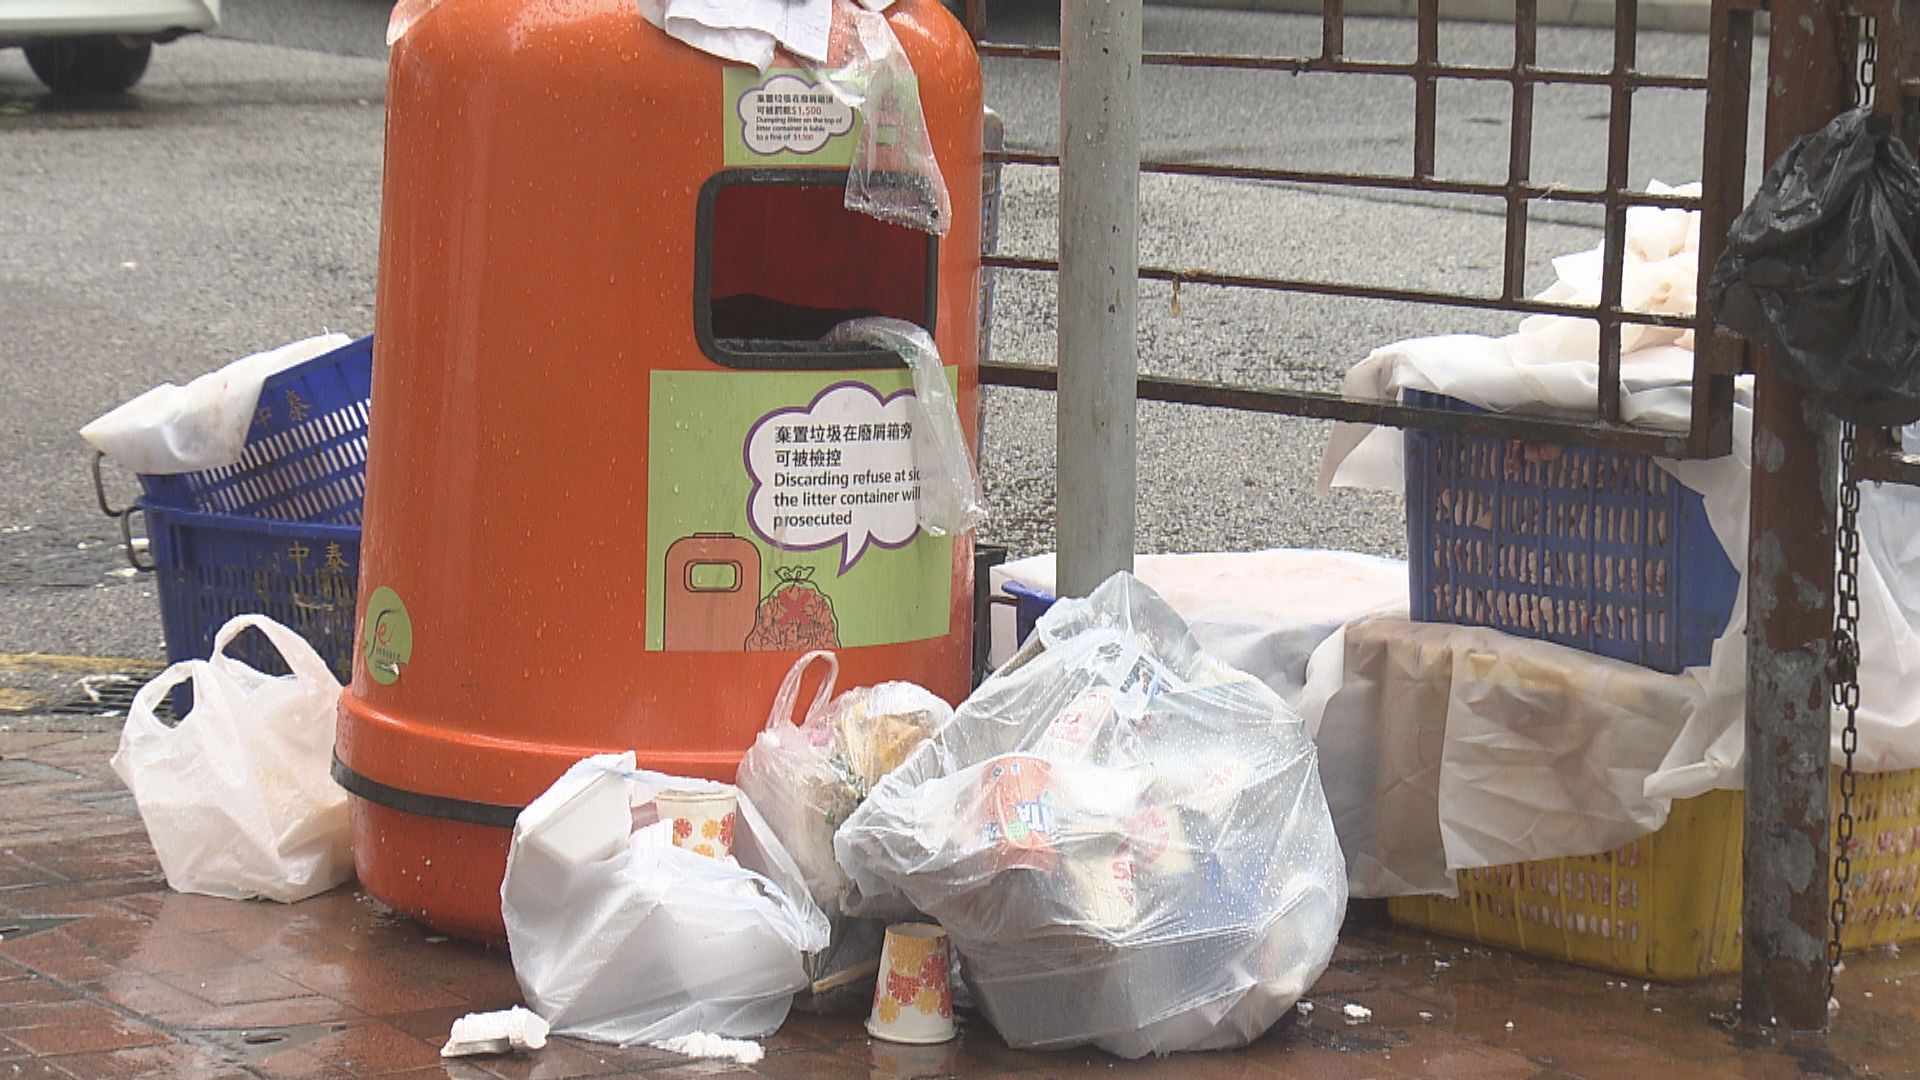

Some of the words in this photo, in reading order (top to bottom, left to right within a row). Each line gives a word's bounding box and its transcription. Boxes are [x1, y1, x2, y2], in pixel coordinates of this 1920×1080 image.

[756, 116, 786, 124] Dumping
[824, 117, 835, 125] top
[775, 422, 913, 443] 棄置垃圾在廢屑箱旁
[775, 448, 842, 467] 可被檢控
[774, 471, 849, 489] Discarding
[853, 468, 892, 485] refuse
[894, 470, 906, 482] at
[774, 492, 799, 507] the
[802, 491, 837, 506] litter
[840, 488, 900, 505] container
[902, 486, 921, 502] will
[773, 510, 853, 531] prosecuted
[287, 540, 350, 575] 中泰
